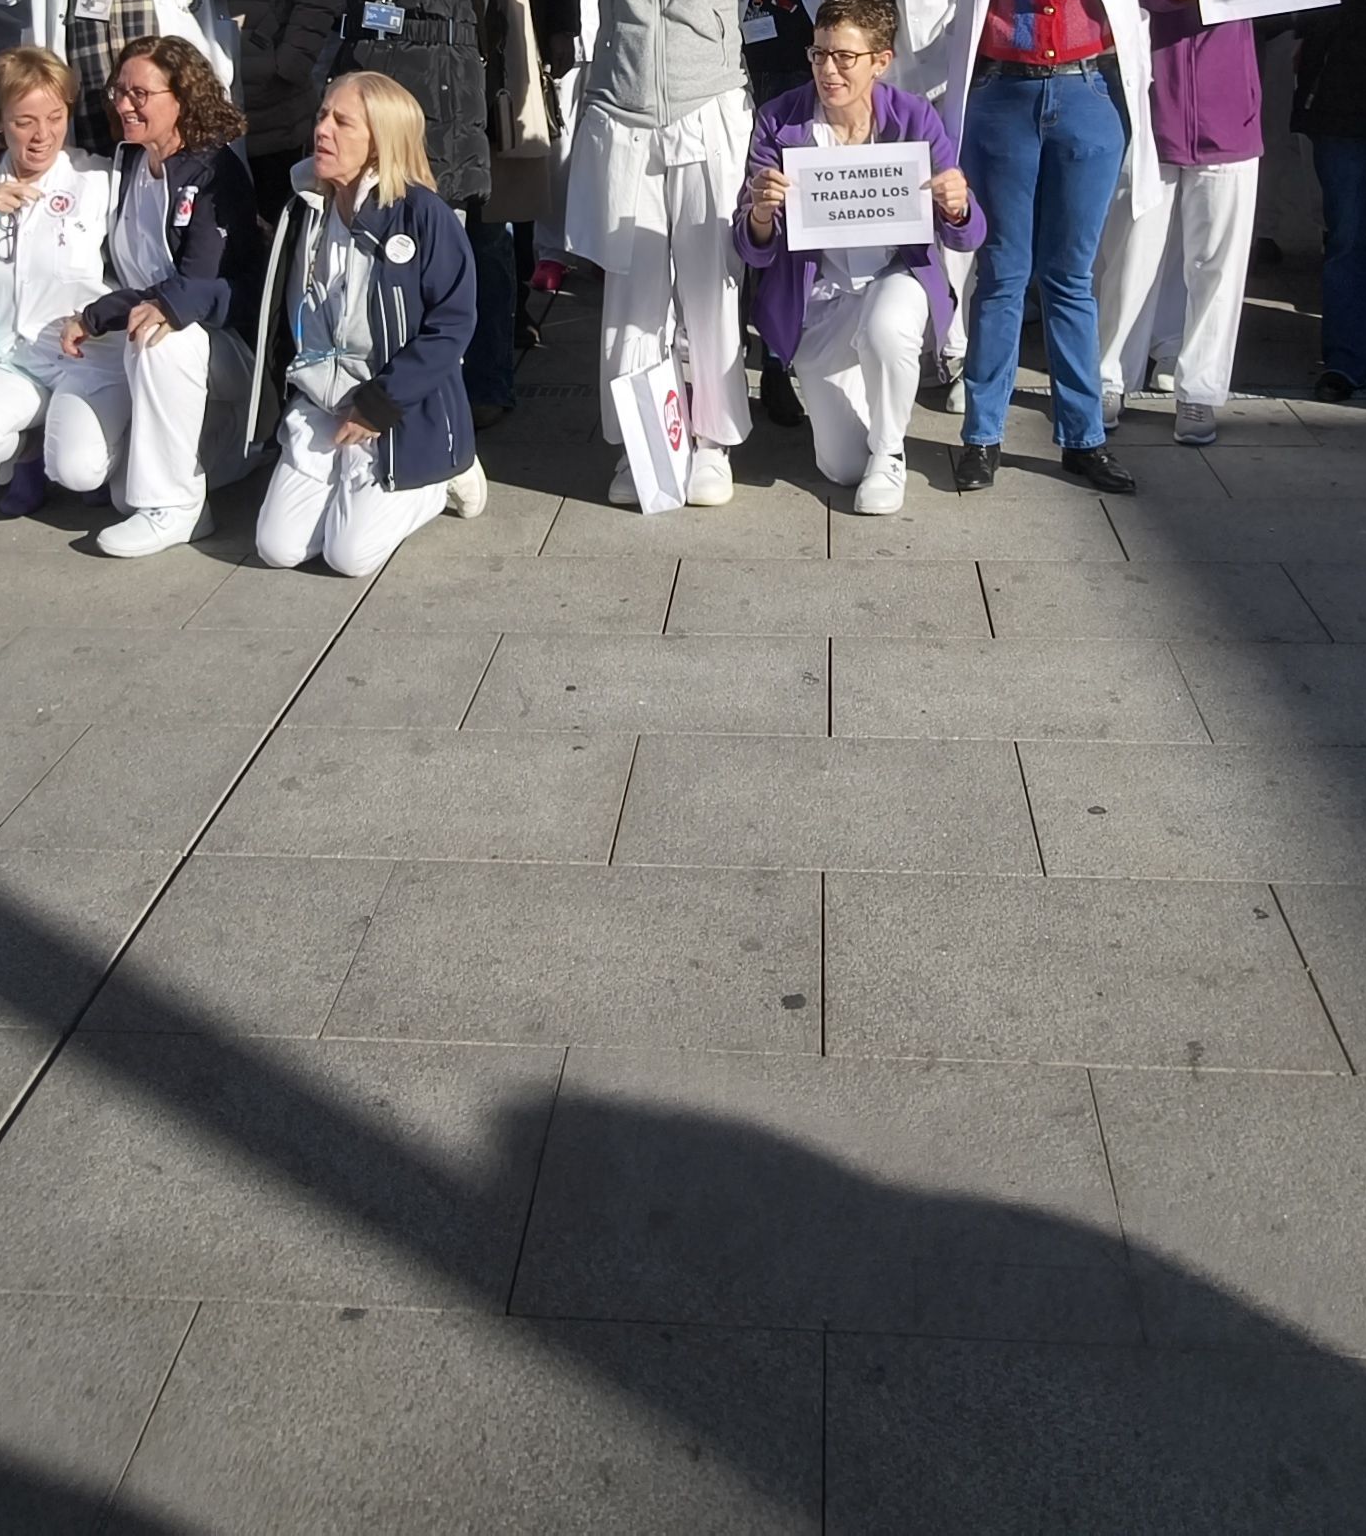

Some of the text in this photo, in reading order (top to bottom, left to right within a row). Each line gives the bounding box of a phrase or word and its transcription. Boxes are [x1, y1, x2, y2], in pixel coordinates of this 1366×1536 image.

[814, 166, 903, 182] YO TAMBIÉN
[811, 186, 910, 202] TRABAJO LOS
[828, 207, 895, 221] SÁBADOS
